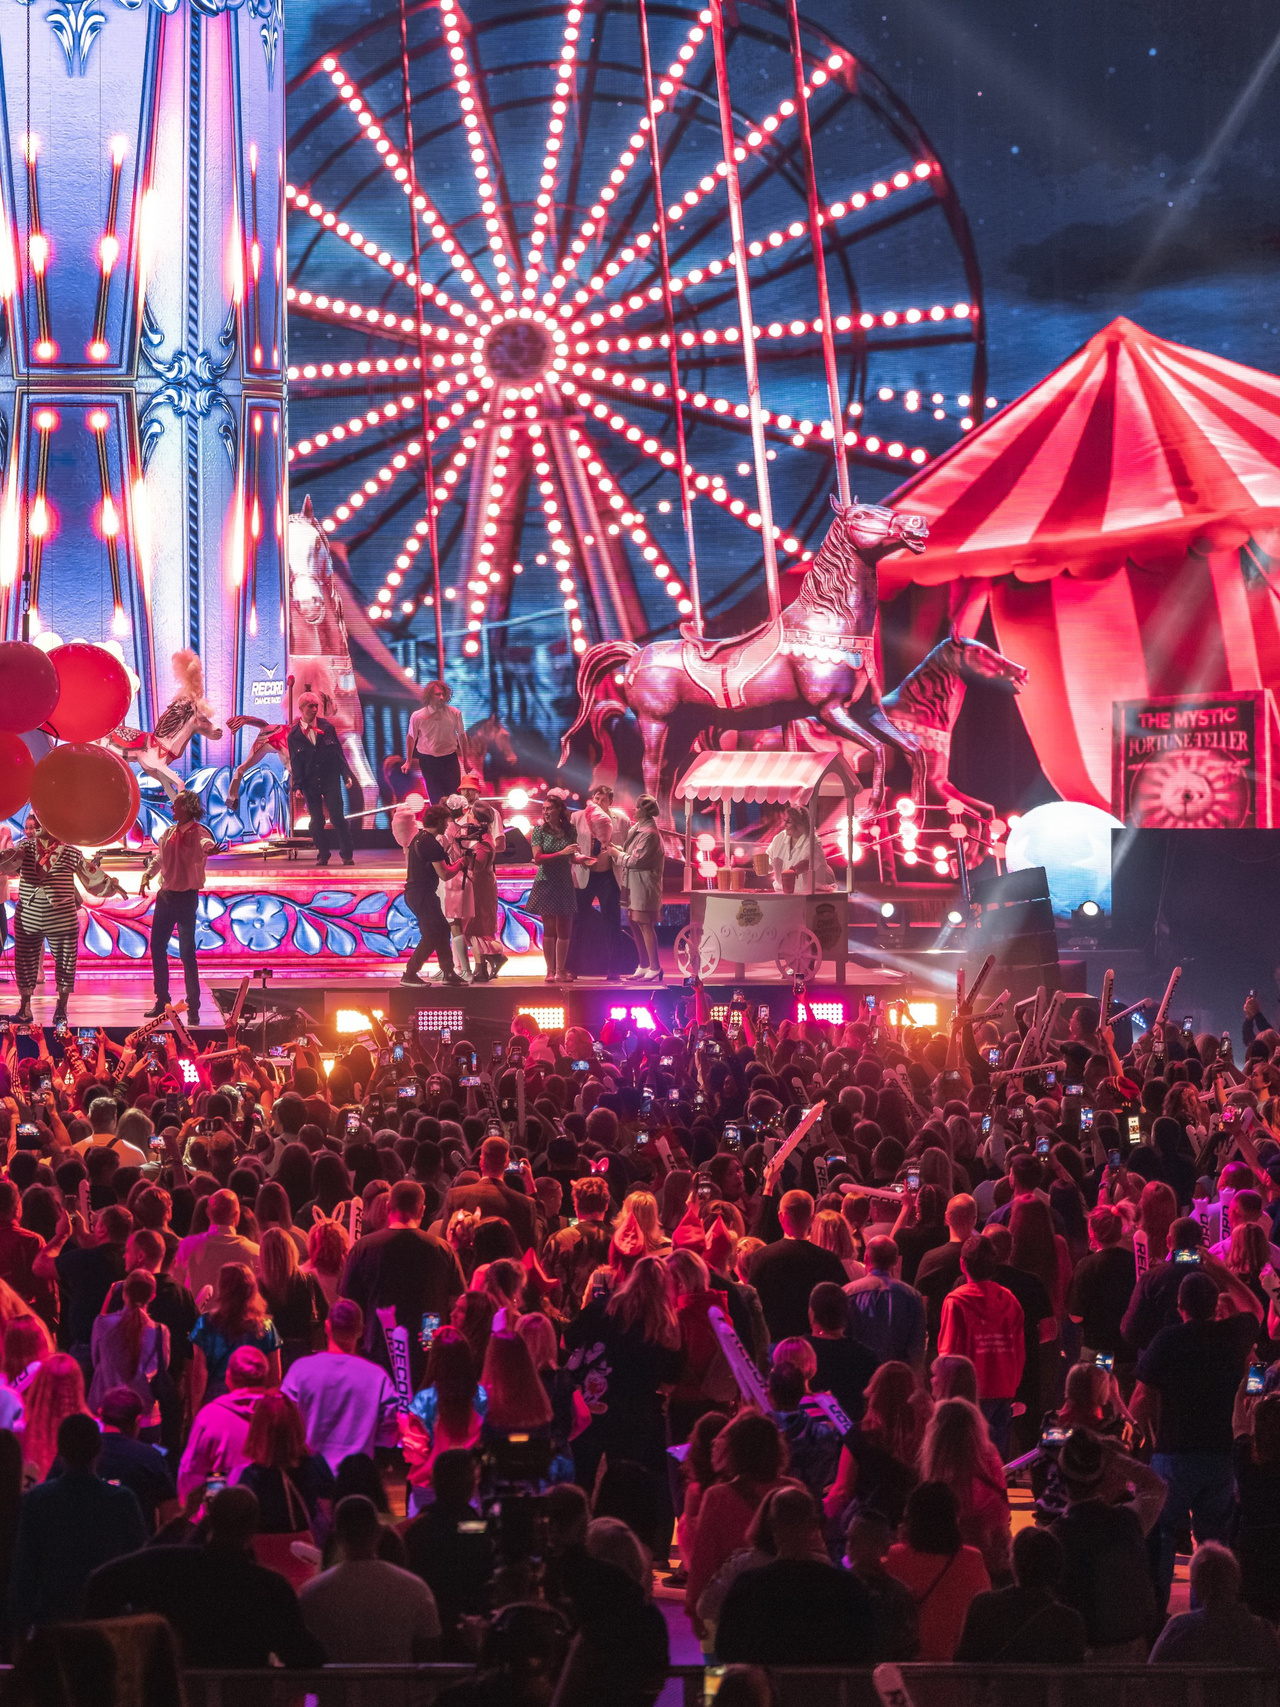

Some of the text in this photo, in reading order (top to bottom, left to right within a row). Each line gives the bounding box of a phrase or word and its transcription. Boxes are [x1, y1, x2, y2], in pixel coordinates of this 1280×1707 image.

[252, 681, 283, 695] RECORD
[1138, 707, 1237, 729] THE MYSTIC
[132, 1011, 170, 1038] RECOR
